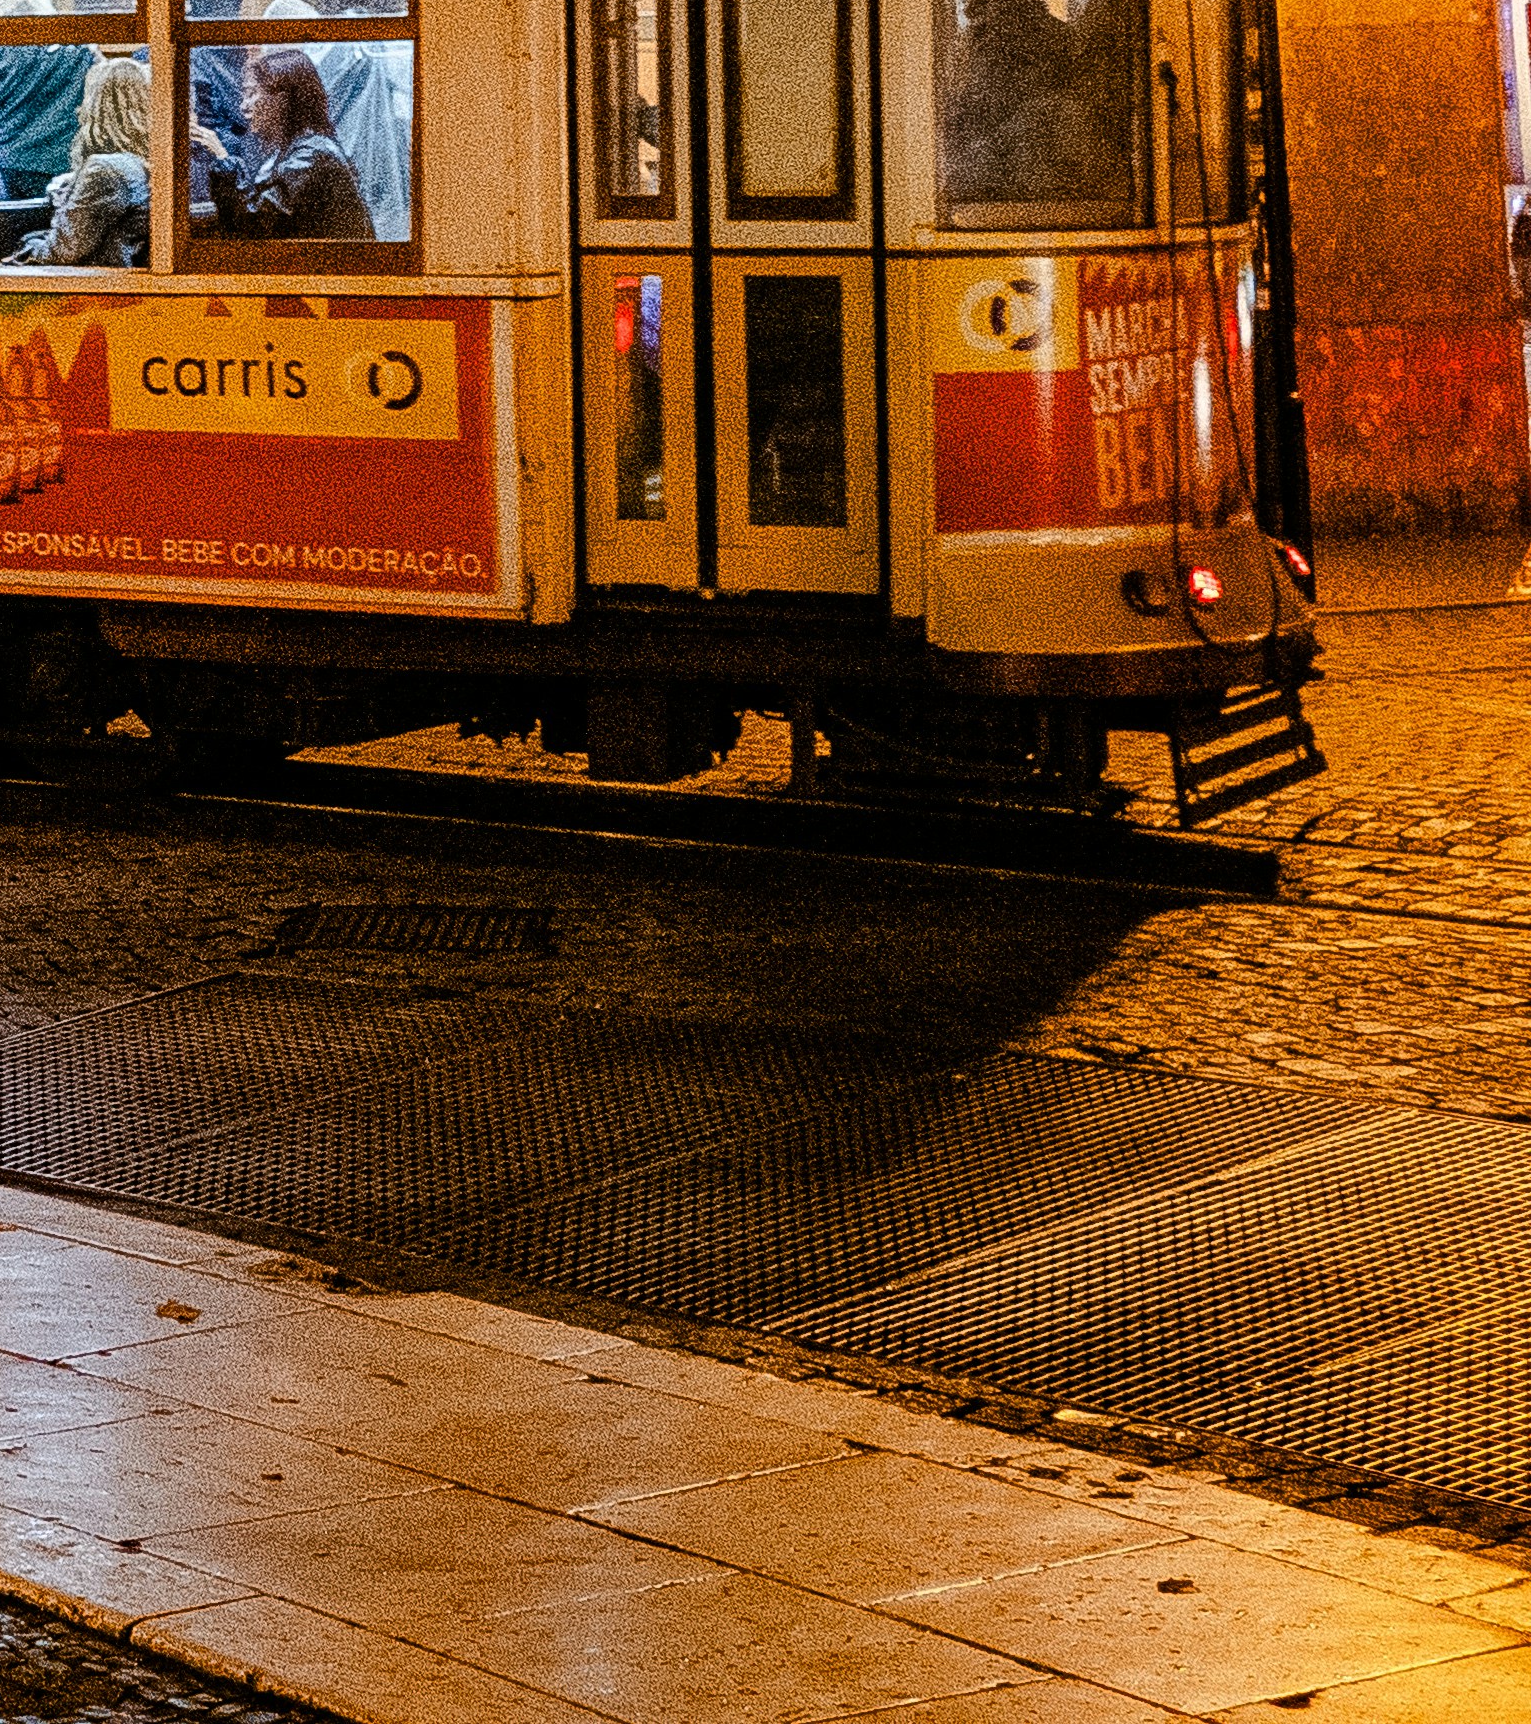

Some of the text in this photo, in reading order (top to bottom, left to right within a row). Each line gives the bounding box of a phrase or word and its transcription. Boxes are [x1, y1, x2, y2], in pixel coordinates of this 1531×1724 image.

[141, 342, 308, 401] carris
[163, 537, 222, 566] BEBE
[230, 542, 296, 569] COM
